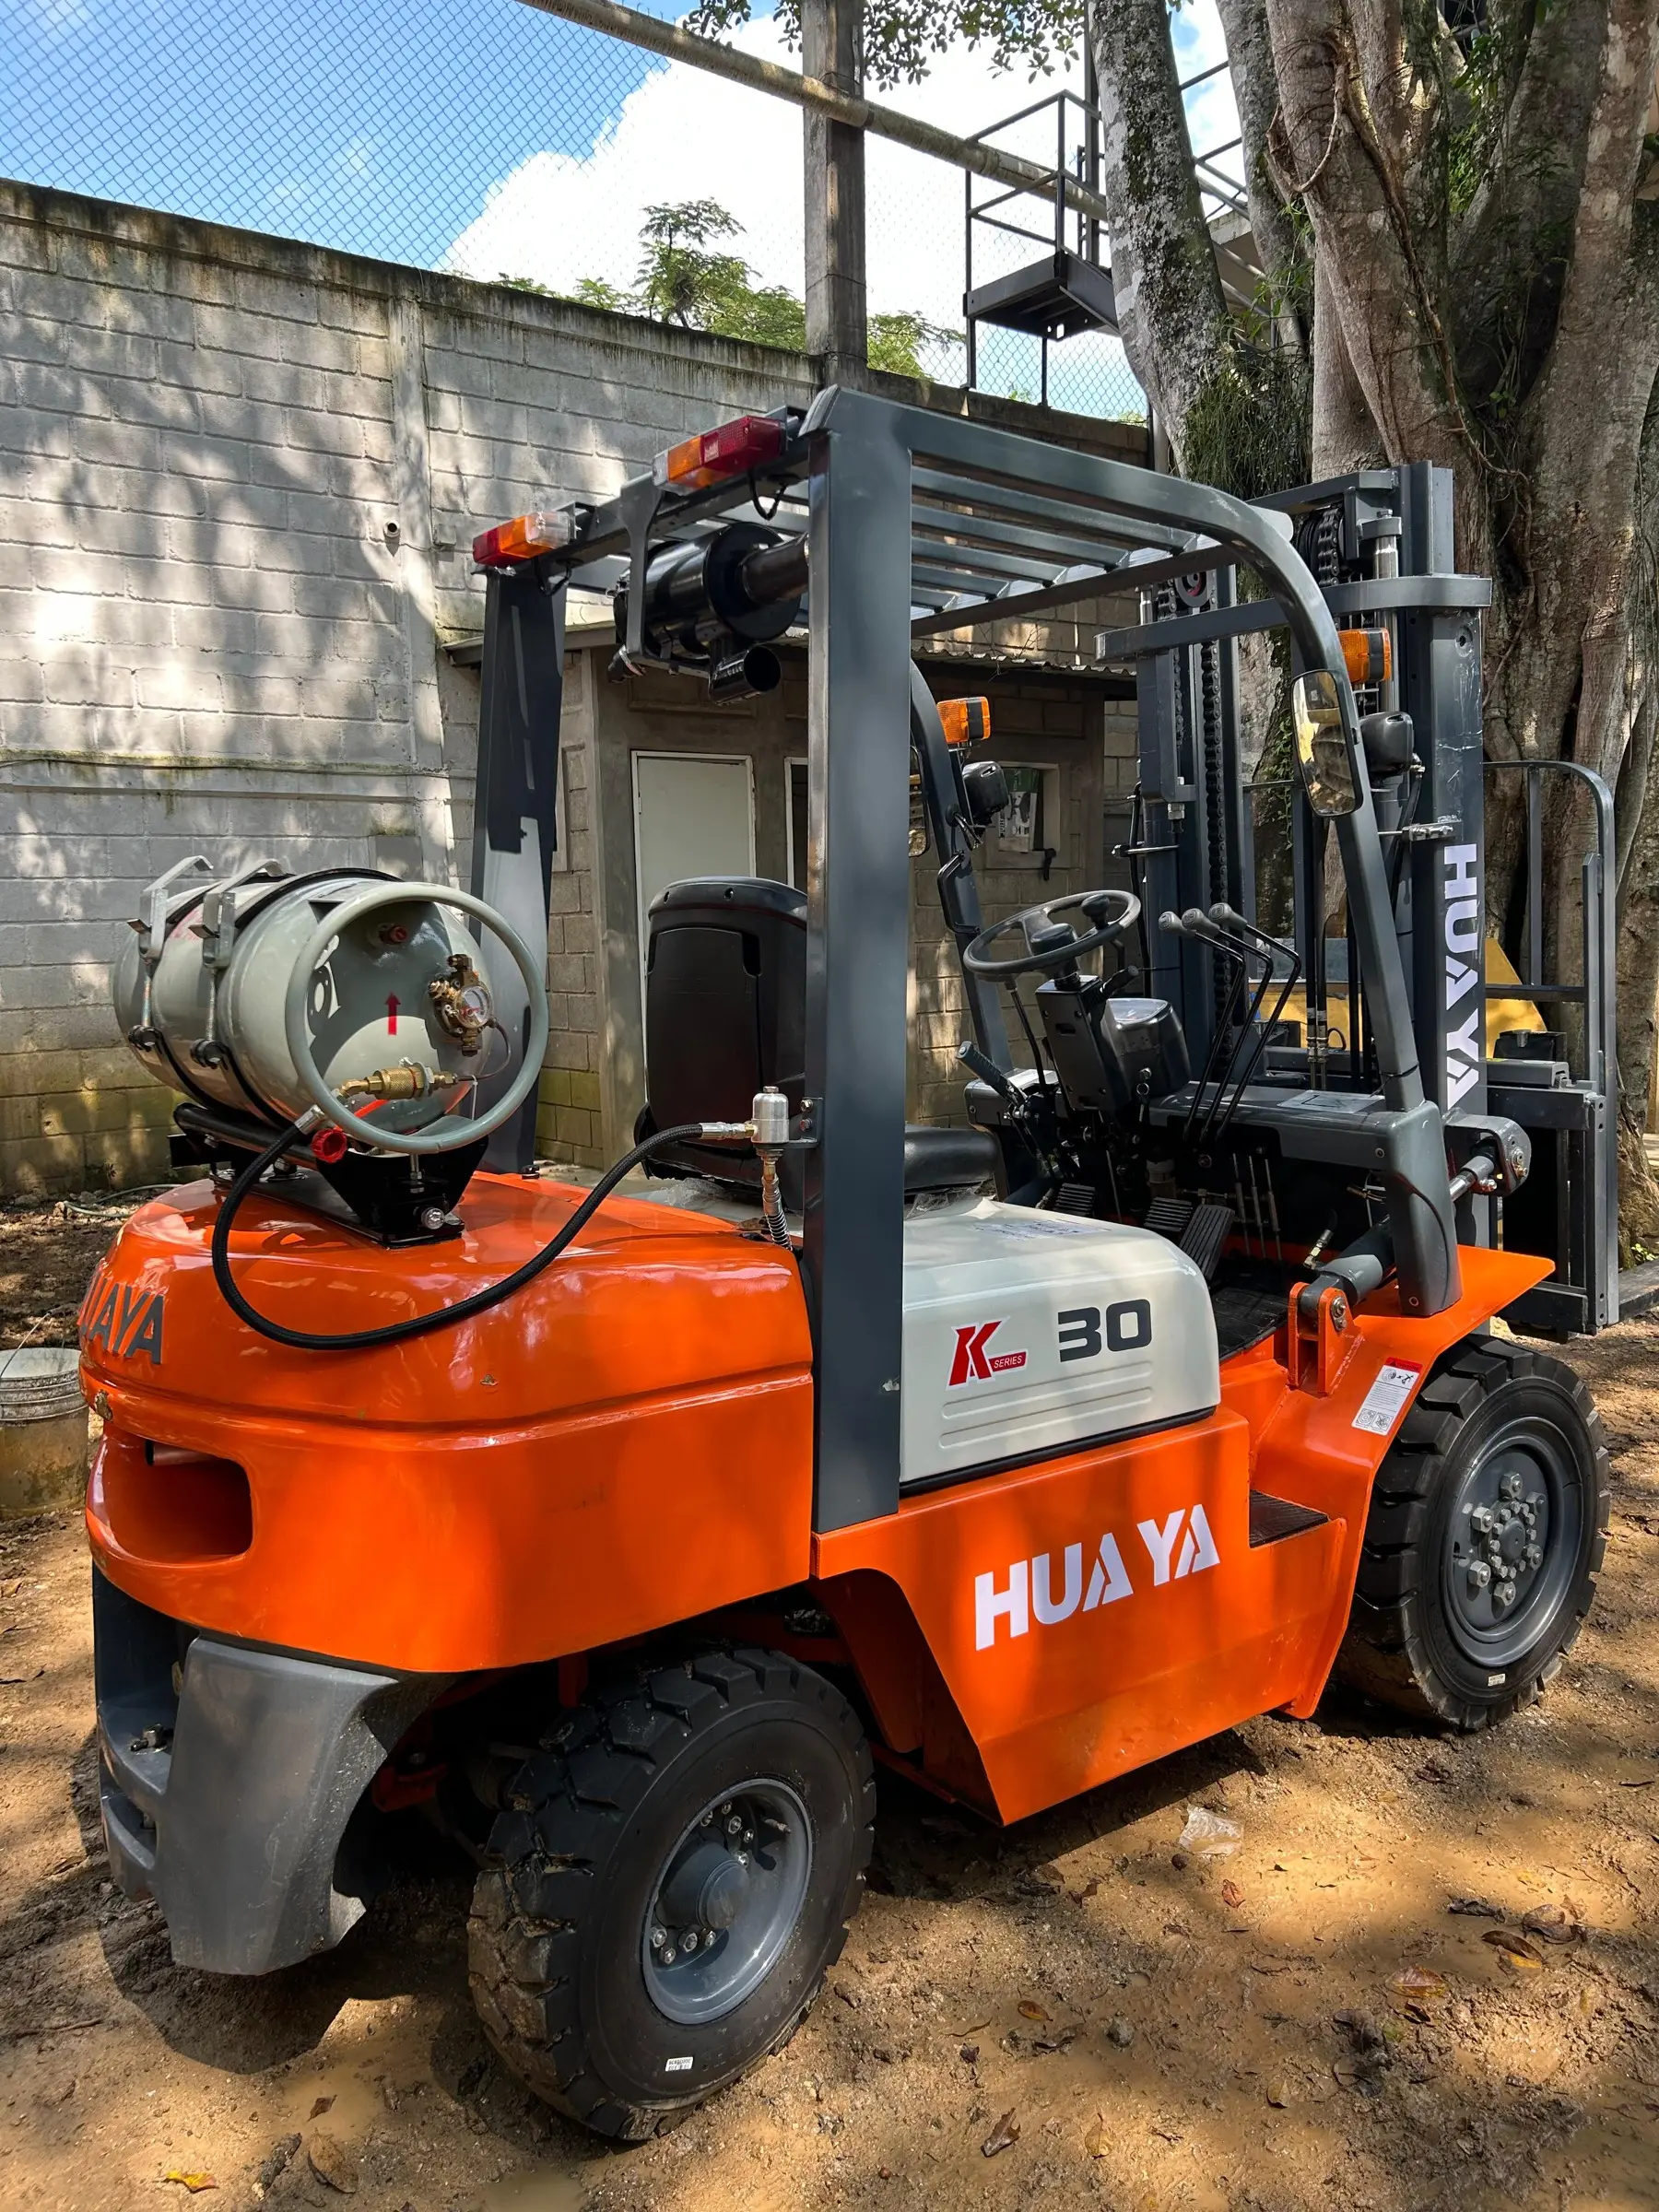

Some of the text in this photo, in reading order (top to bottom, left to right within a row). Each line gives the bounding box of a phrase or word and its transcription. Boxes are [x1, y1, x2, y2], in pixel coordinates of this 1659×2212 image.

[1443, 843, 1479, 1111] HUAYA
[948, 1320, 1023, 1386] K SERIES
[1057, 1298, 1153, 1363] 30
